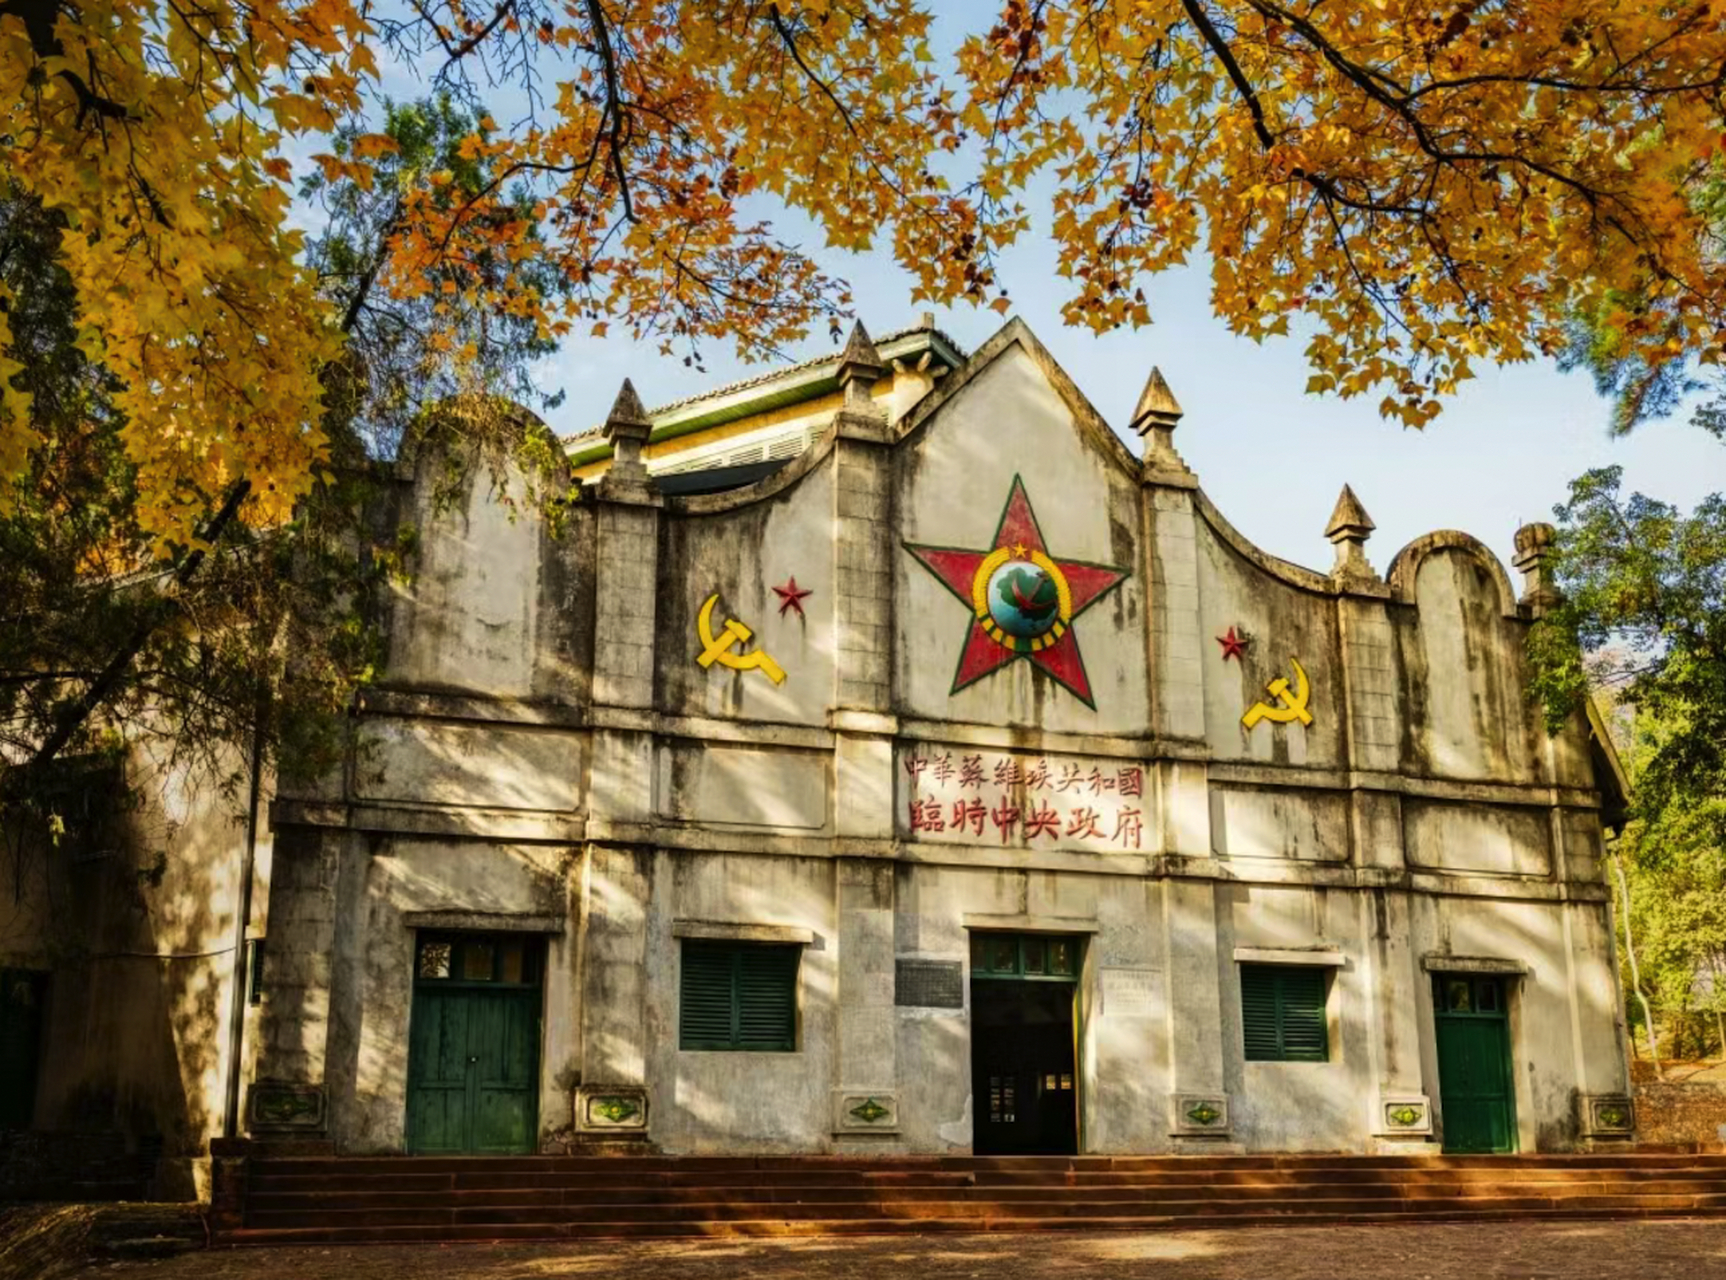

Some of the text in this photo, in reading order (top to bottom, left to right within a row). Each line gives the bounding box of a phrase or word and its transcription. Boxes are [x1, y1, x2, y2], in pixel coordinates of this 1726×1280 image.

[908, 795, 1143, 849] 臨時中央政府
